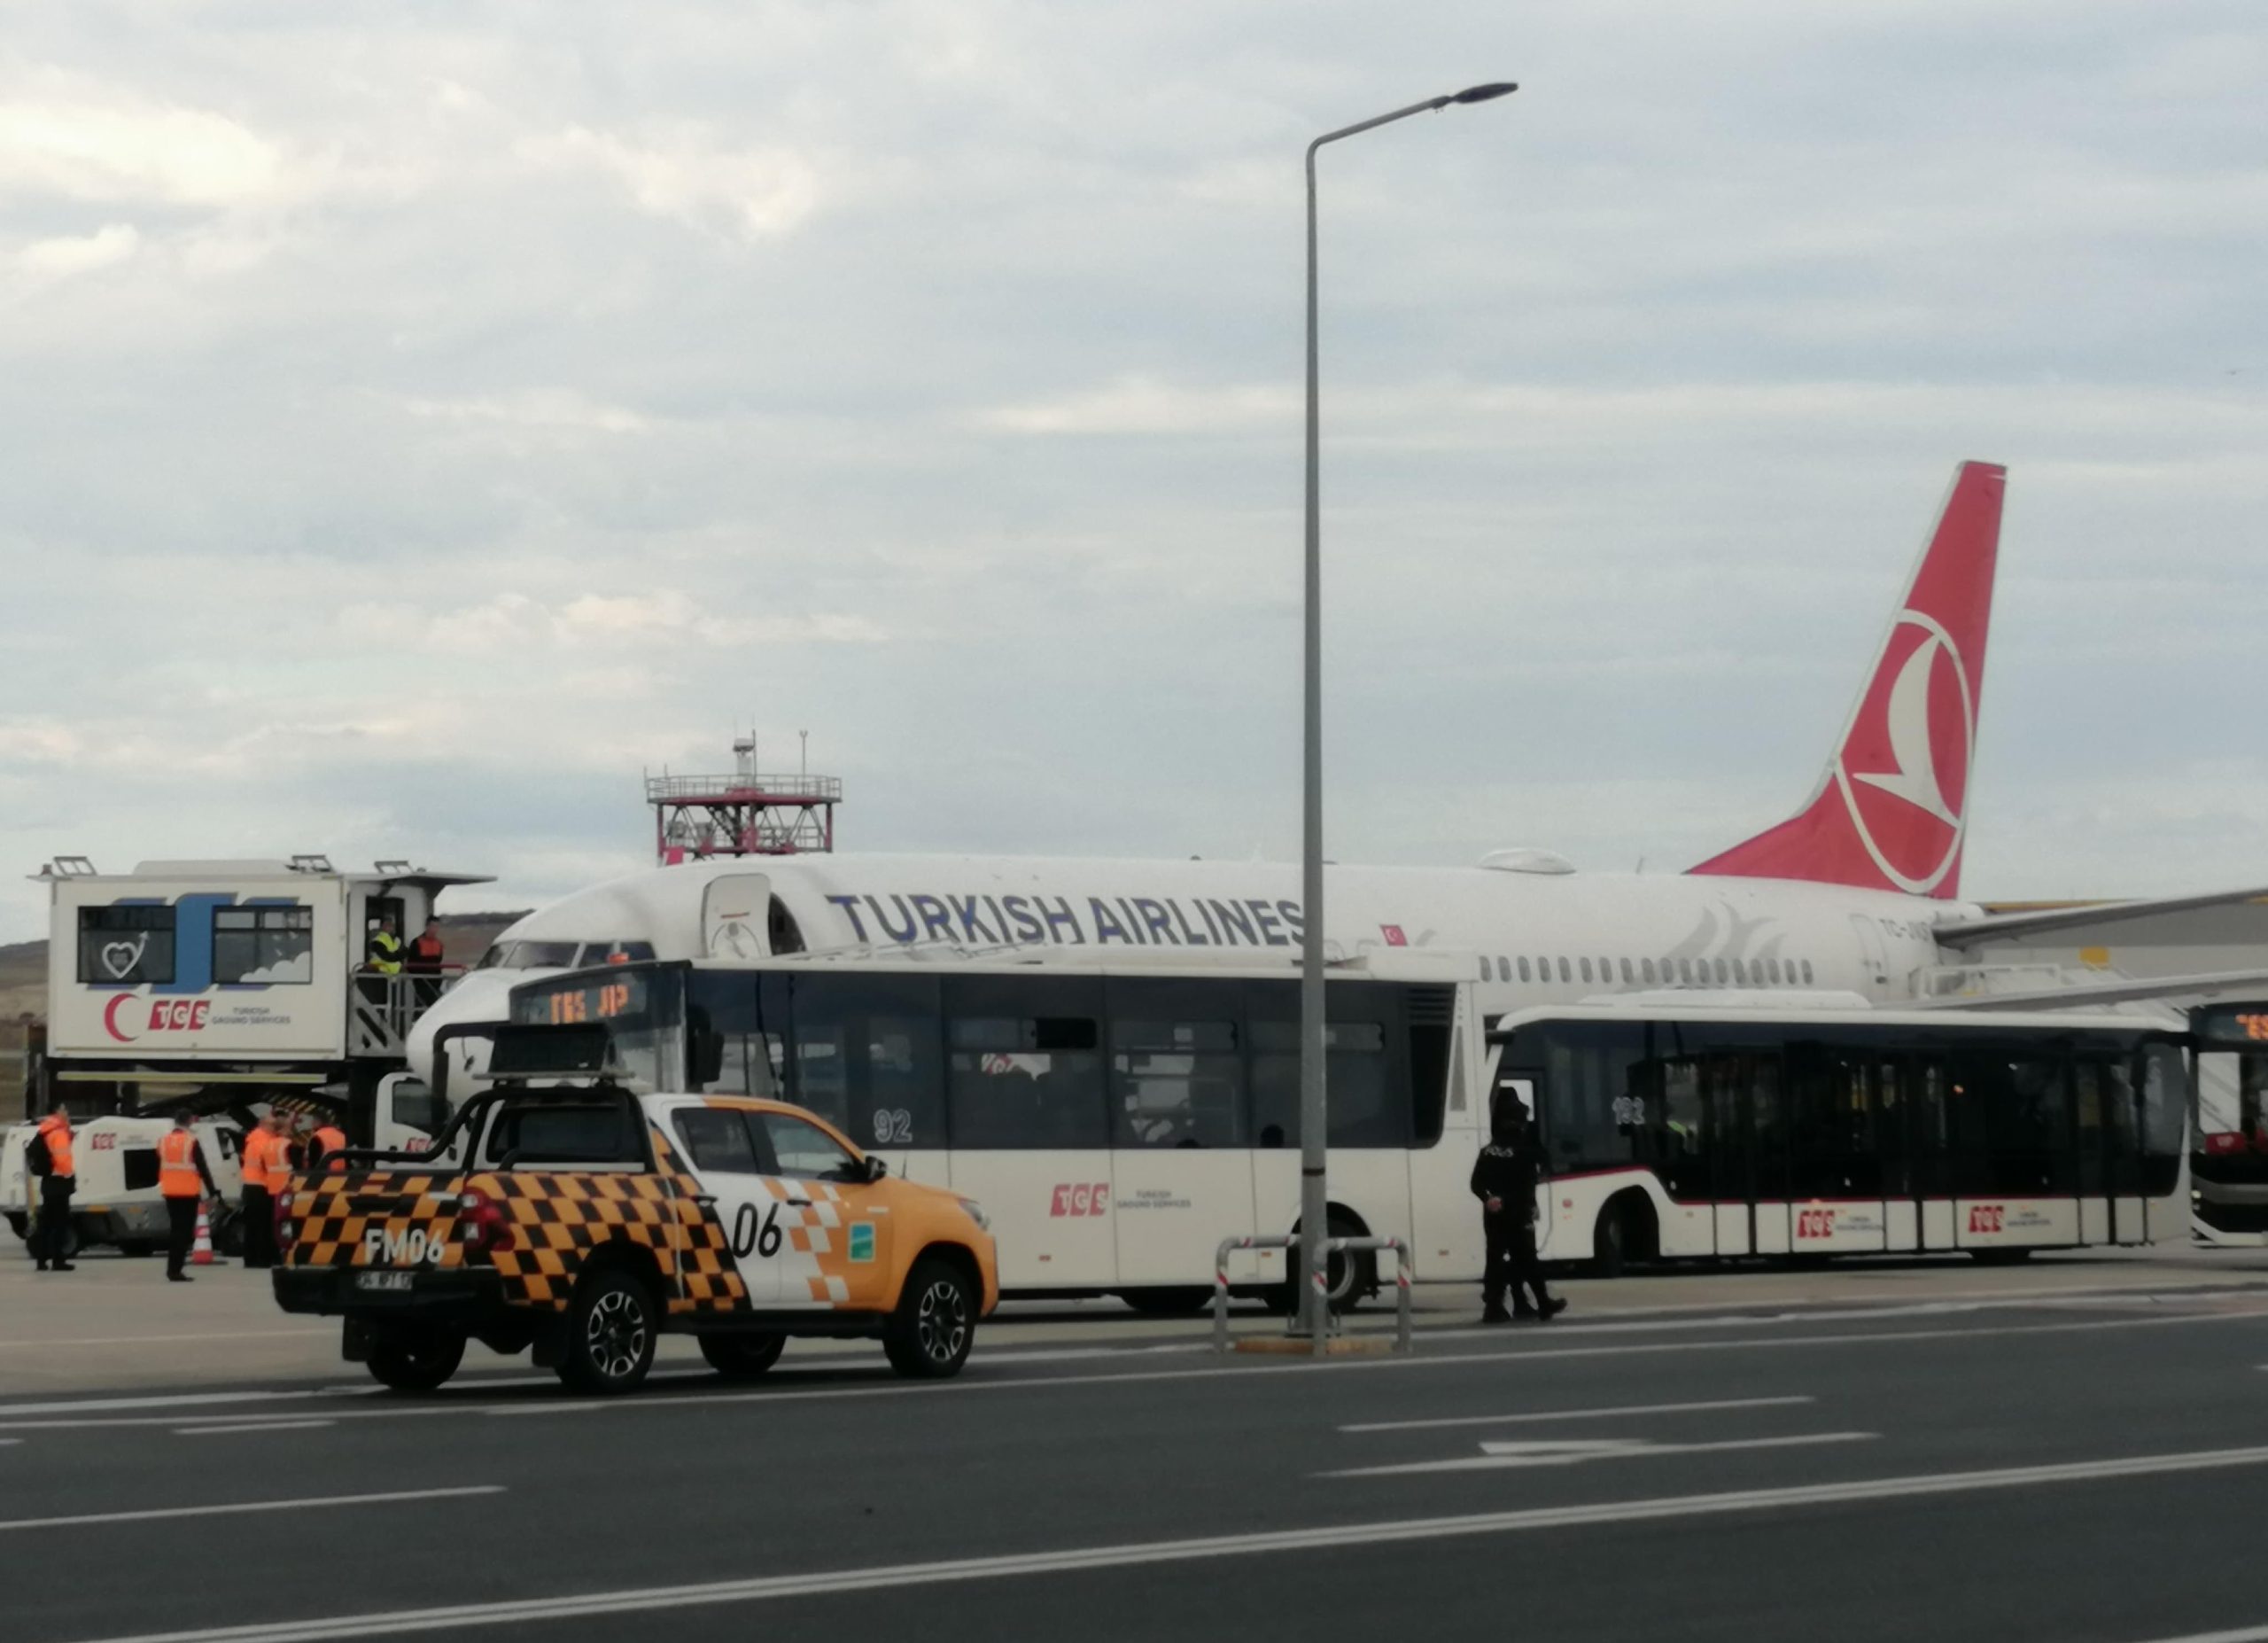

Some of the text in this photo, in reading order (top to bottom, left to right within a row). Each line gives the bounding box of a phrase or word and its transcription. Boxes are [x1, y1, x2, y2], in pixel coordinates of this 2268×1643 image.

[825, 894, 1304, 946] TURKISH AIRLINES
[148, 1000, 212, 1031] TGS
[874, 1109, 913, 1143] 92
[1049, 1183, 1109, 1218] TGS
[1136, 1189, 1172, 1198] TURKISH
[365, 1227, 445, 1265] FM06
[732, 1202, 782, 1258] 06
